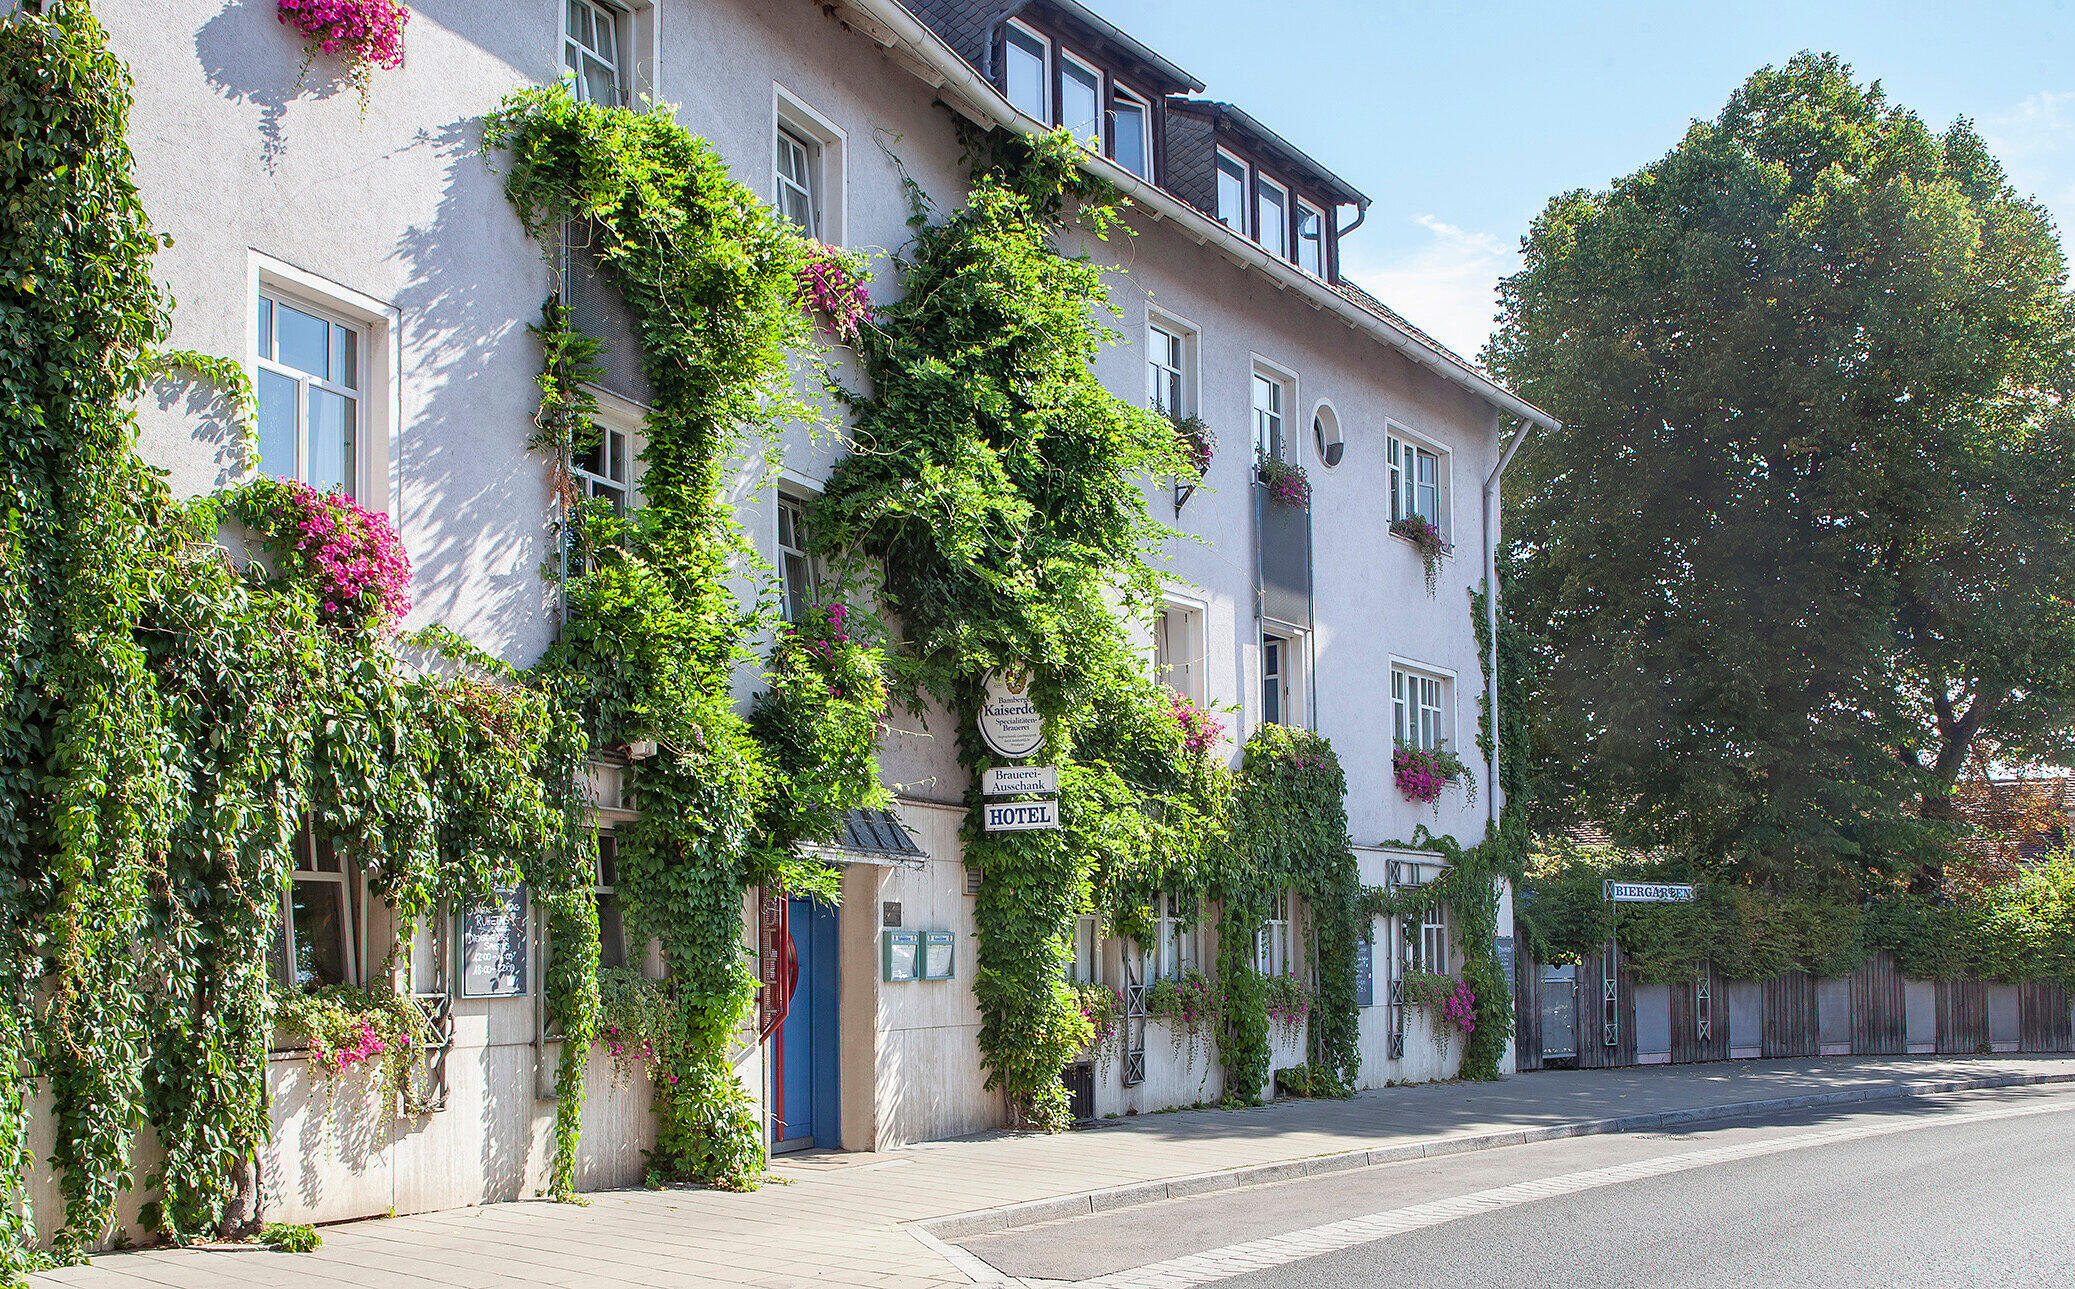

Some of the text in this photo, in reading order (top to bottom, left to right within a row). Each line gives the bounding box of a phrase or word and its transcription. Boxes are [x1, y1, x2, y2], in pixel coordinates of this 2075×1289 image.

[983, 703, 1037, 717] Kaiserdo
[1003, 724, 1030, 732] Brauerei
[995, 770, 1042, 780] Brauerei-
[992, 779, 1046, 792] Ausschank
[989, 806, 1051, 826] HOTEL
